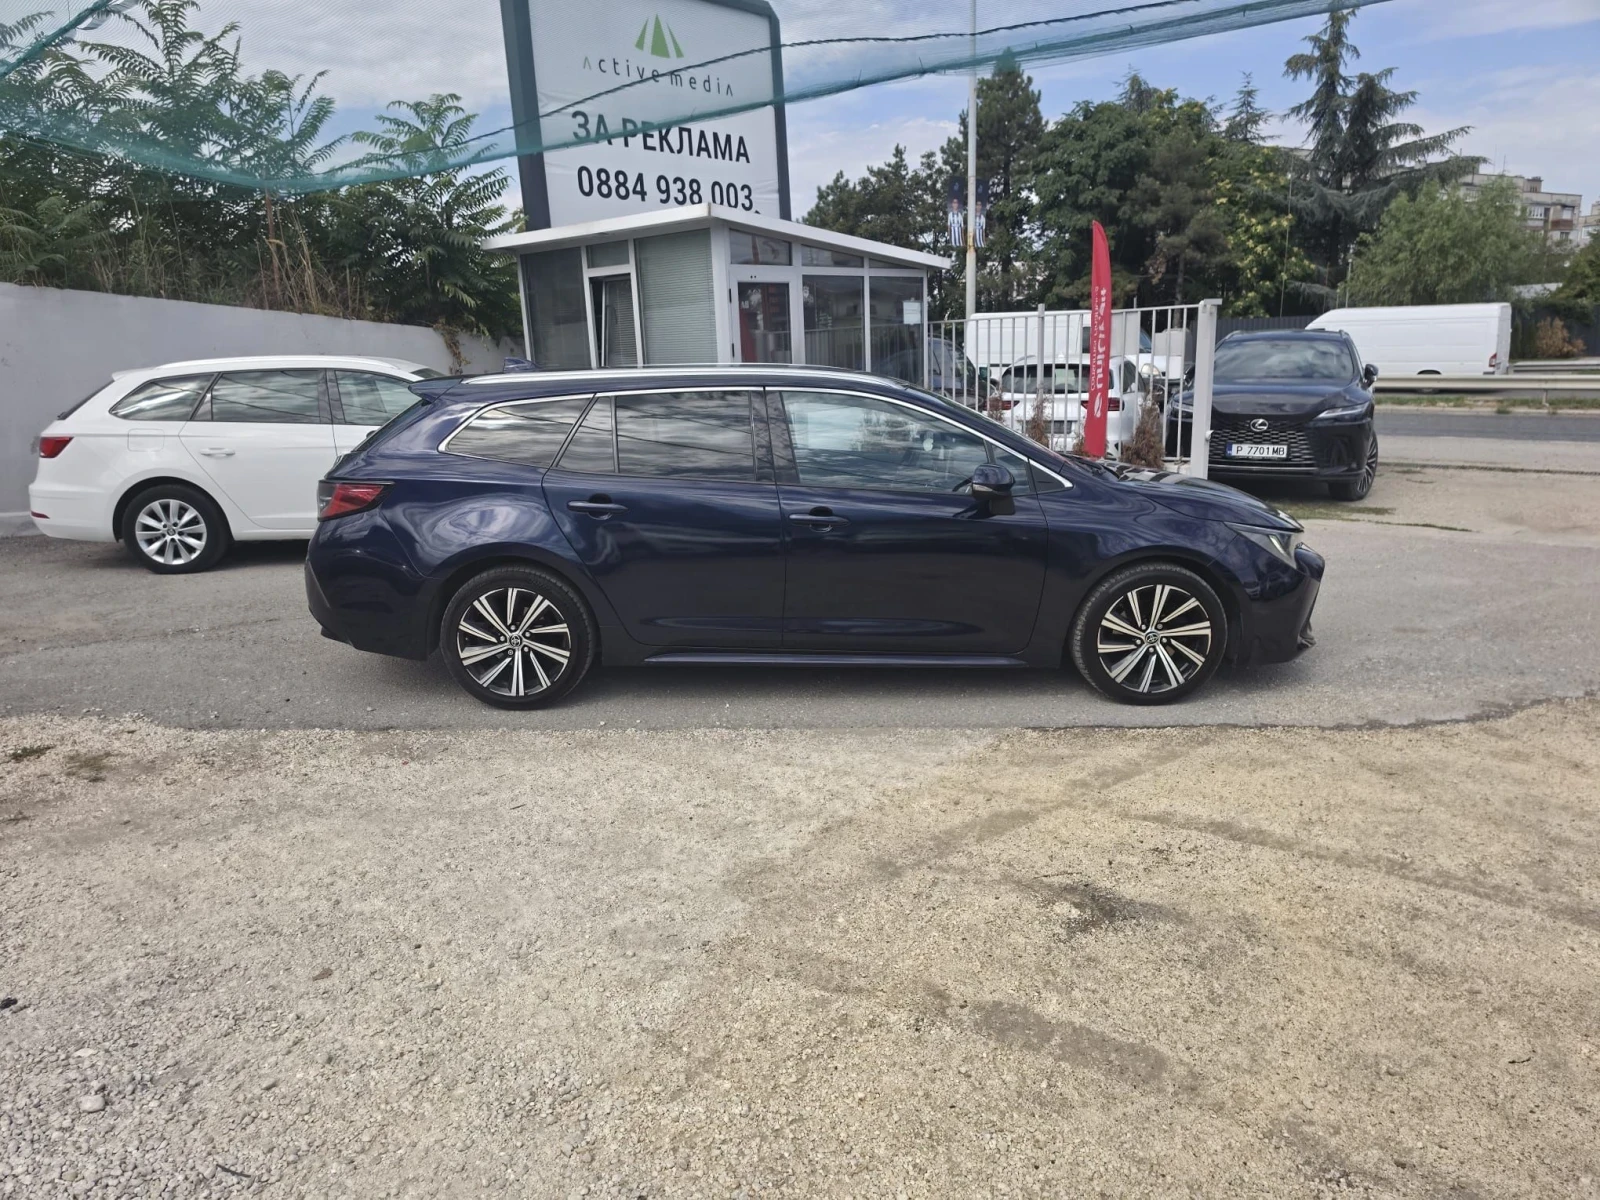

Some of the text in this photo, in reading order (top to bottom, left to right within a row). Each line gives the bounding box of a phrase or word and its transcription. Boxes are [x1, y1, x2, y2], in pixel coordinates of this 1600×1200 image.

[571, 110, 751, 164] ЗА РЕКЛАМА
[577, 165, 754, 212] 0884 938 003
[1236, 446, 1242, 455] P
